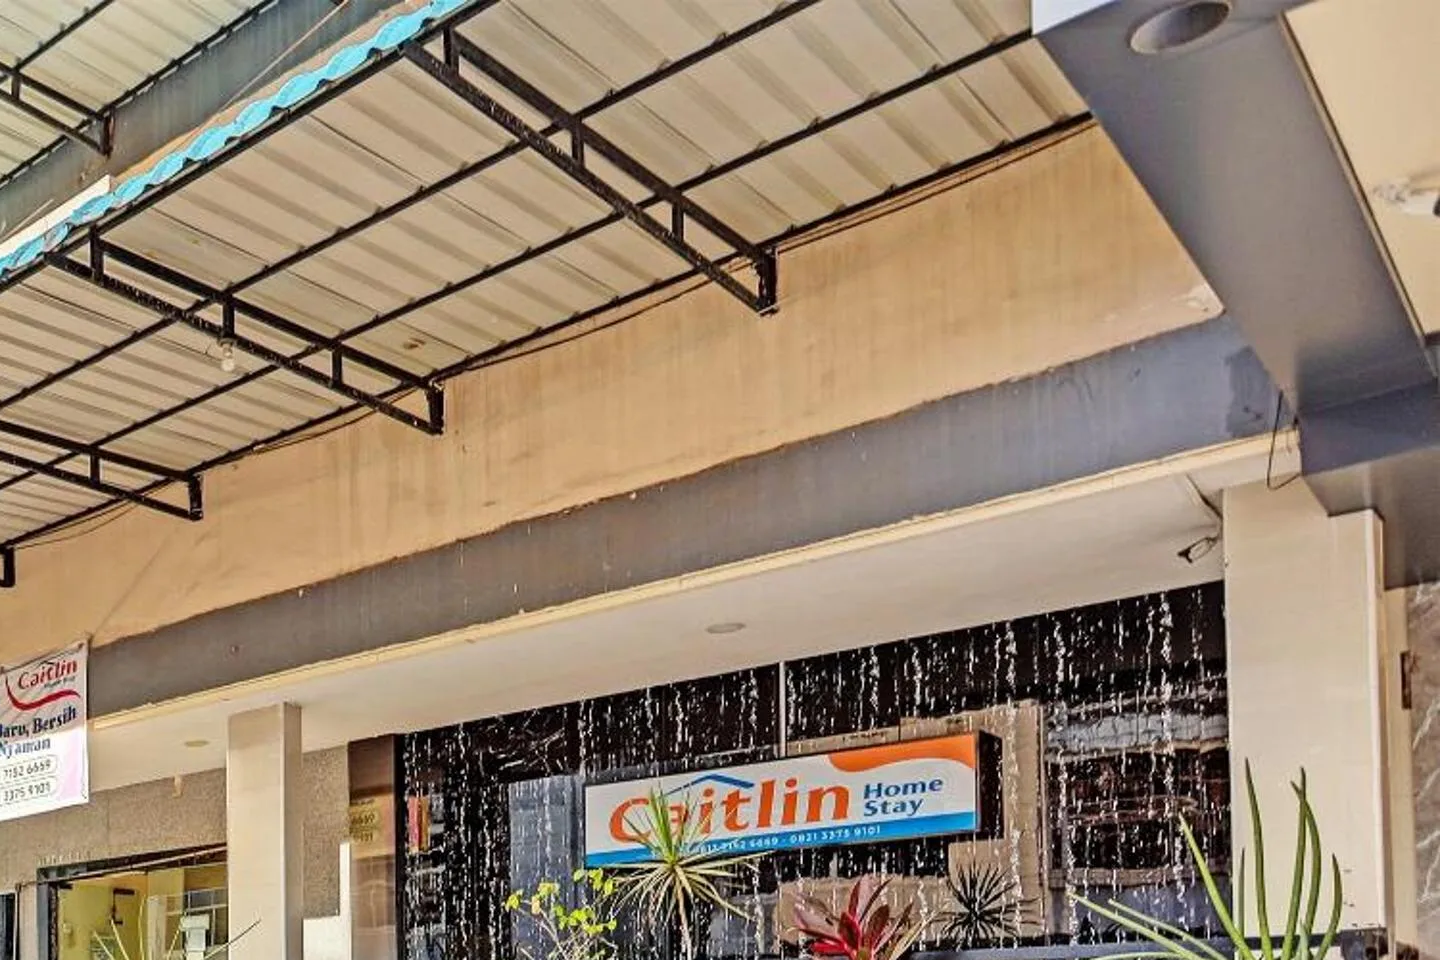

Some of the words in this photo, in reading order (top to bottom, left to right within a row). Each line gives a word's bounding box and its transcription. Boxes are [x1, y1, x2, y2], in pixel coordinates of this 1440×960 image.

[17, 660, 78, 690] Caitlin
[32, 705, 77, 735] Bersih
[863, 778, 944, 800] Home
[609, 777, 851, 845] Caitlin
[863, 798, 924, 817] Stay
